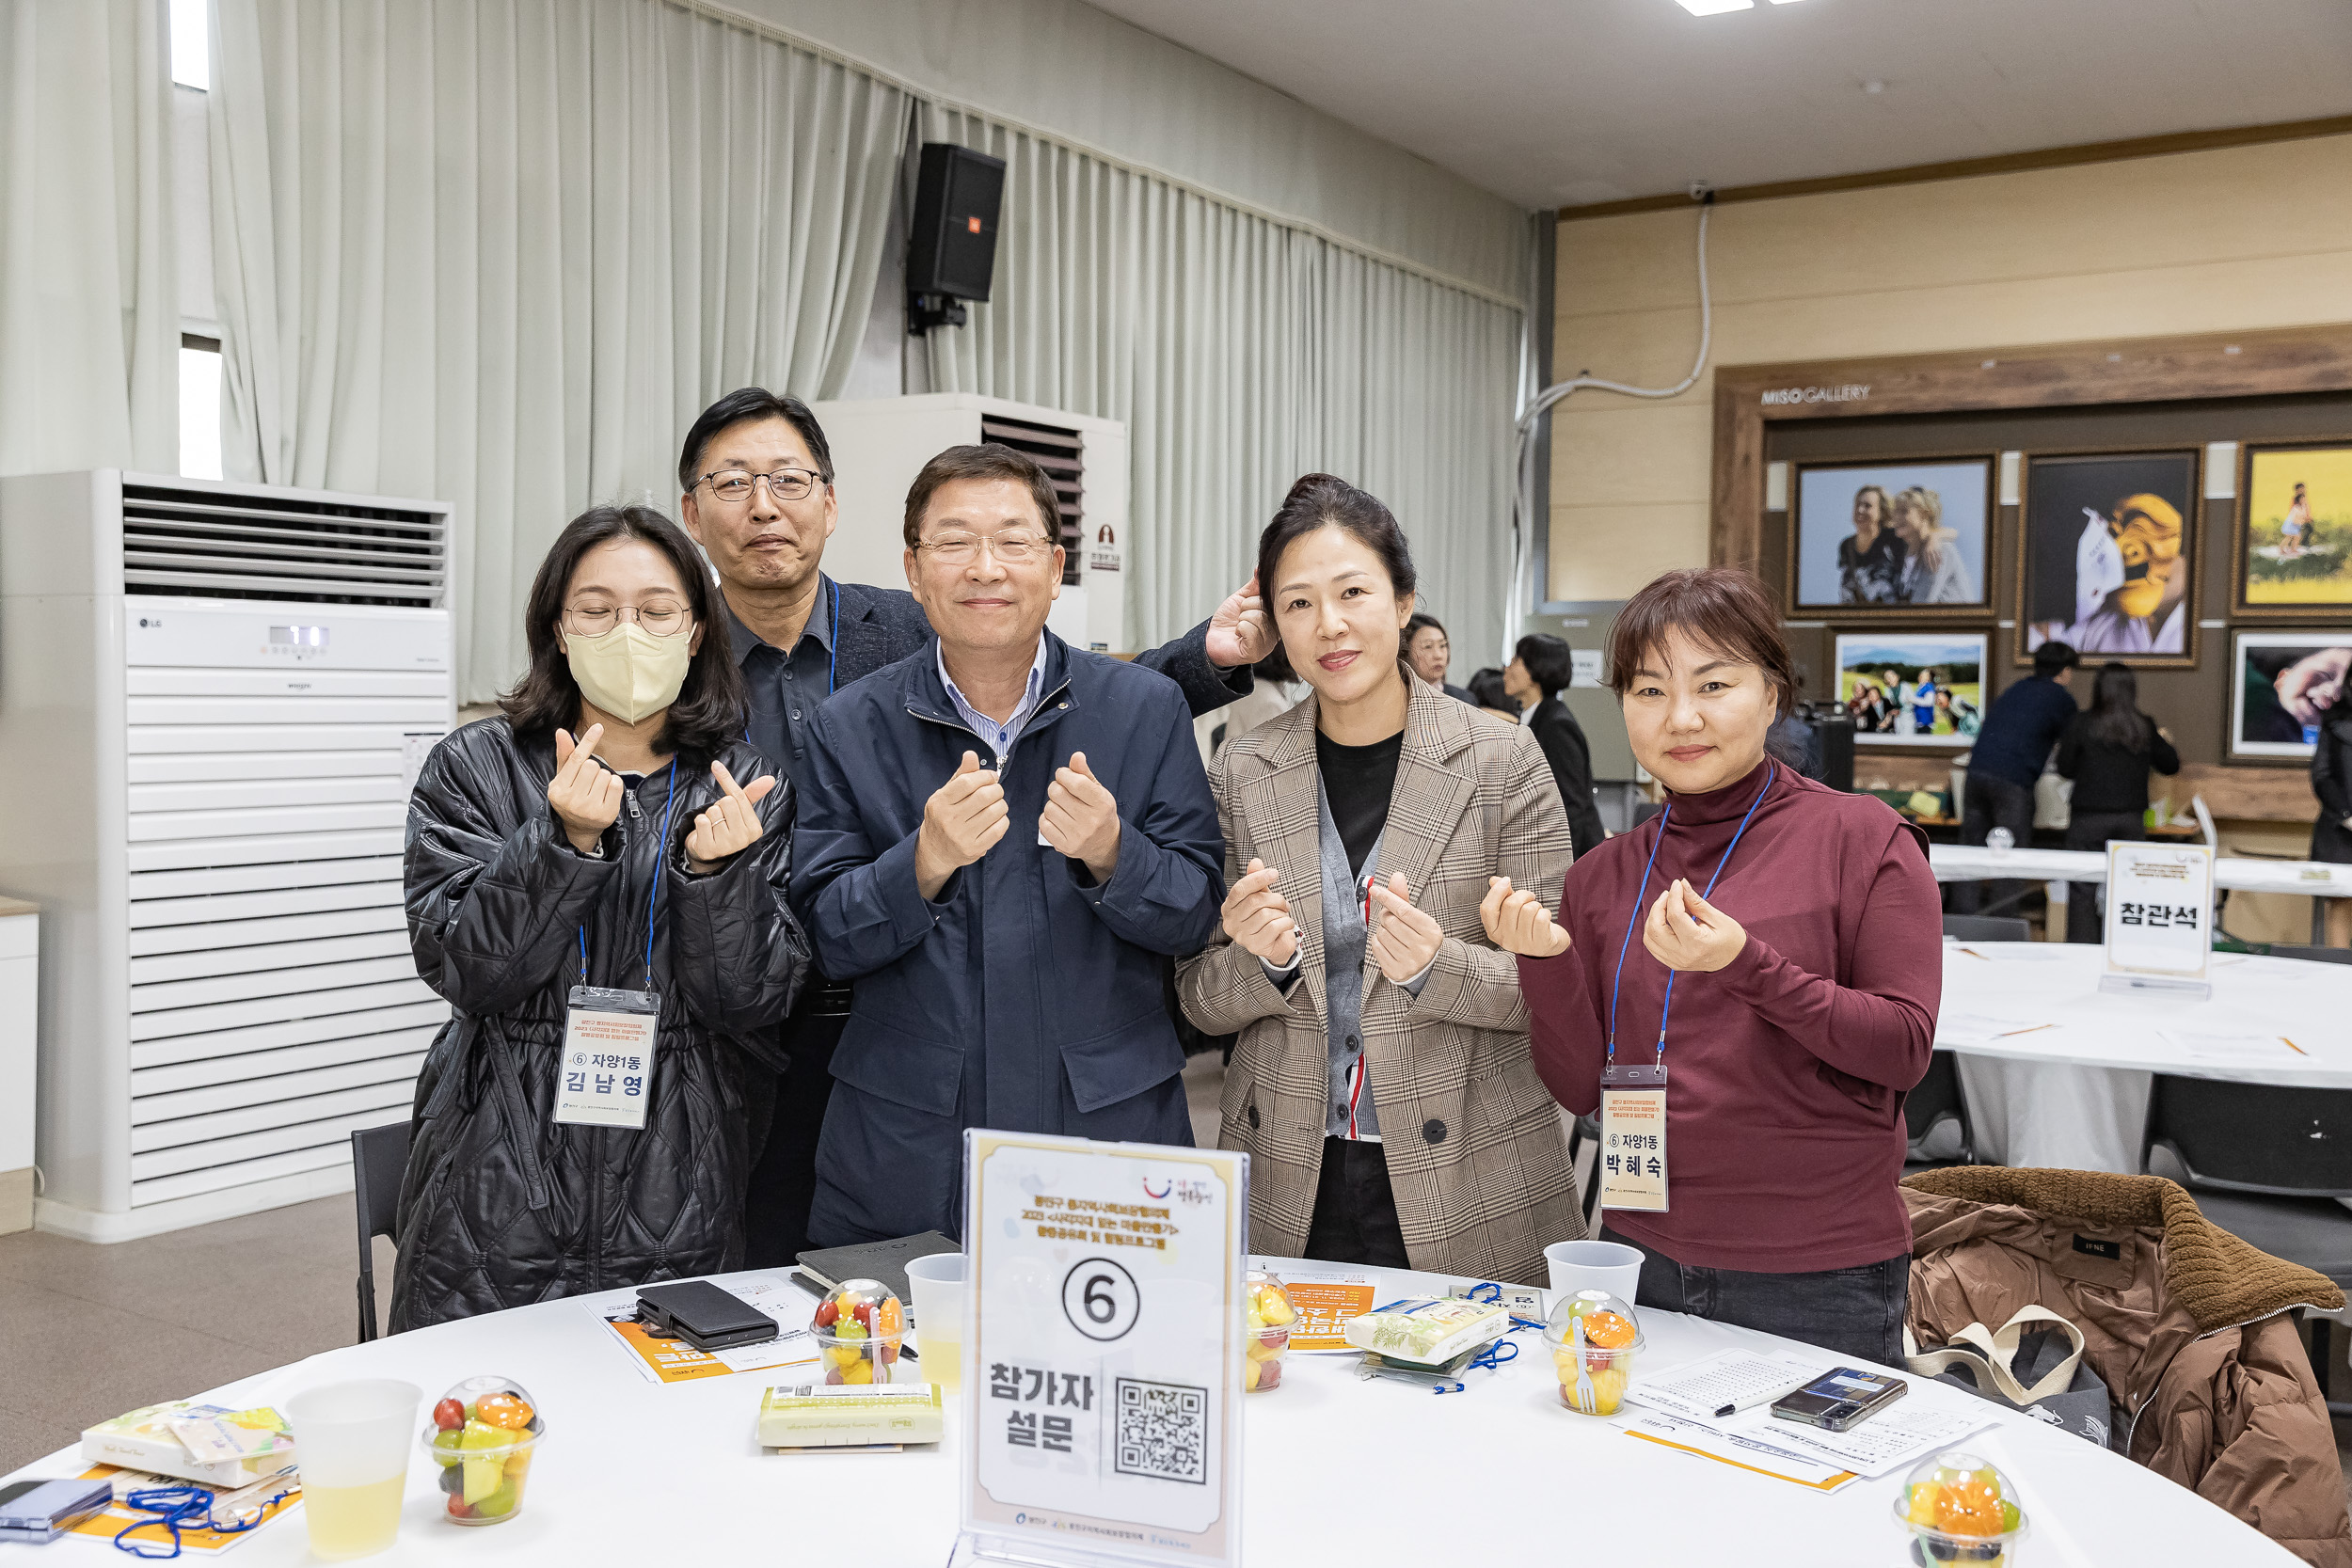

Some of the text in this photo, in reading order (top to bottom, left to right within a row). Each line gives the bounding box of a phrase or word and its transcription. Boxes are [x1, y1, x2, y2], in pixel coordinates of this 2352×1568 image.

[2121, 902, 2198, 929] 참관석
[592, 1053, 641, 1070] 자양1동
[1623, 1133, 1658, 1150] 자양1동
[991, 1362, 1094, 1411] 참가자
[1007, 1409, 1073, 1453] 설문
